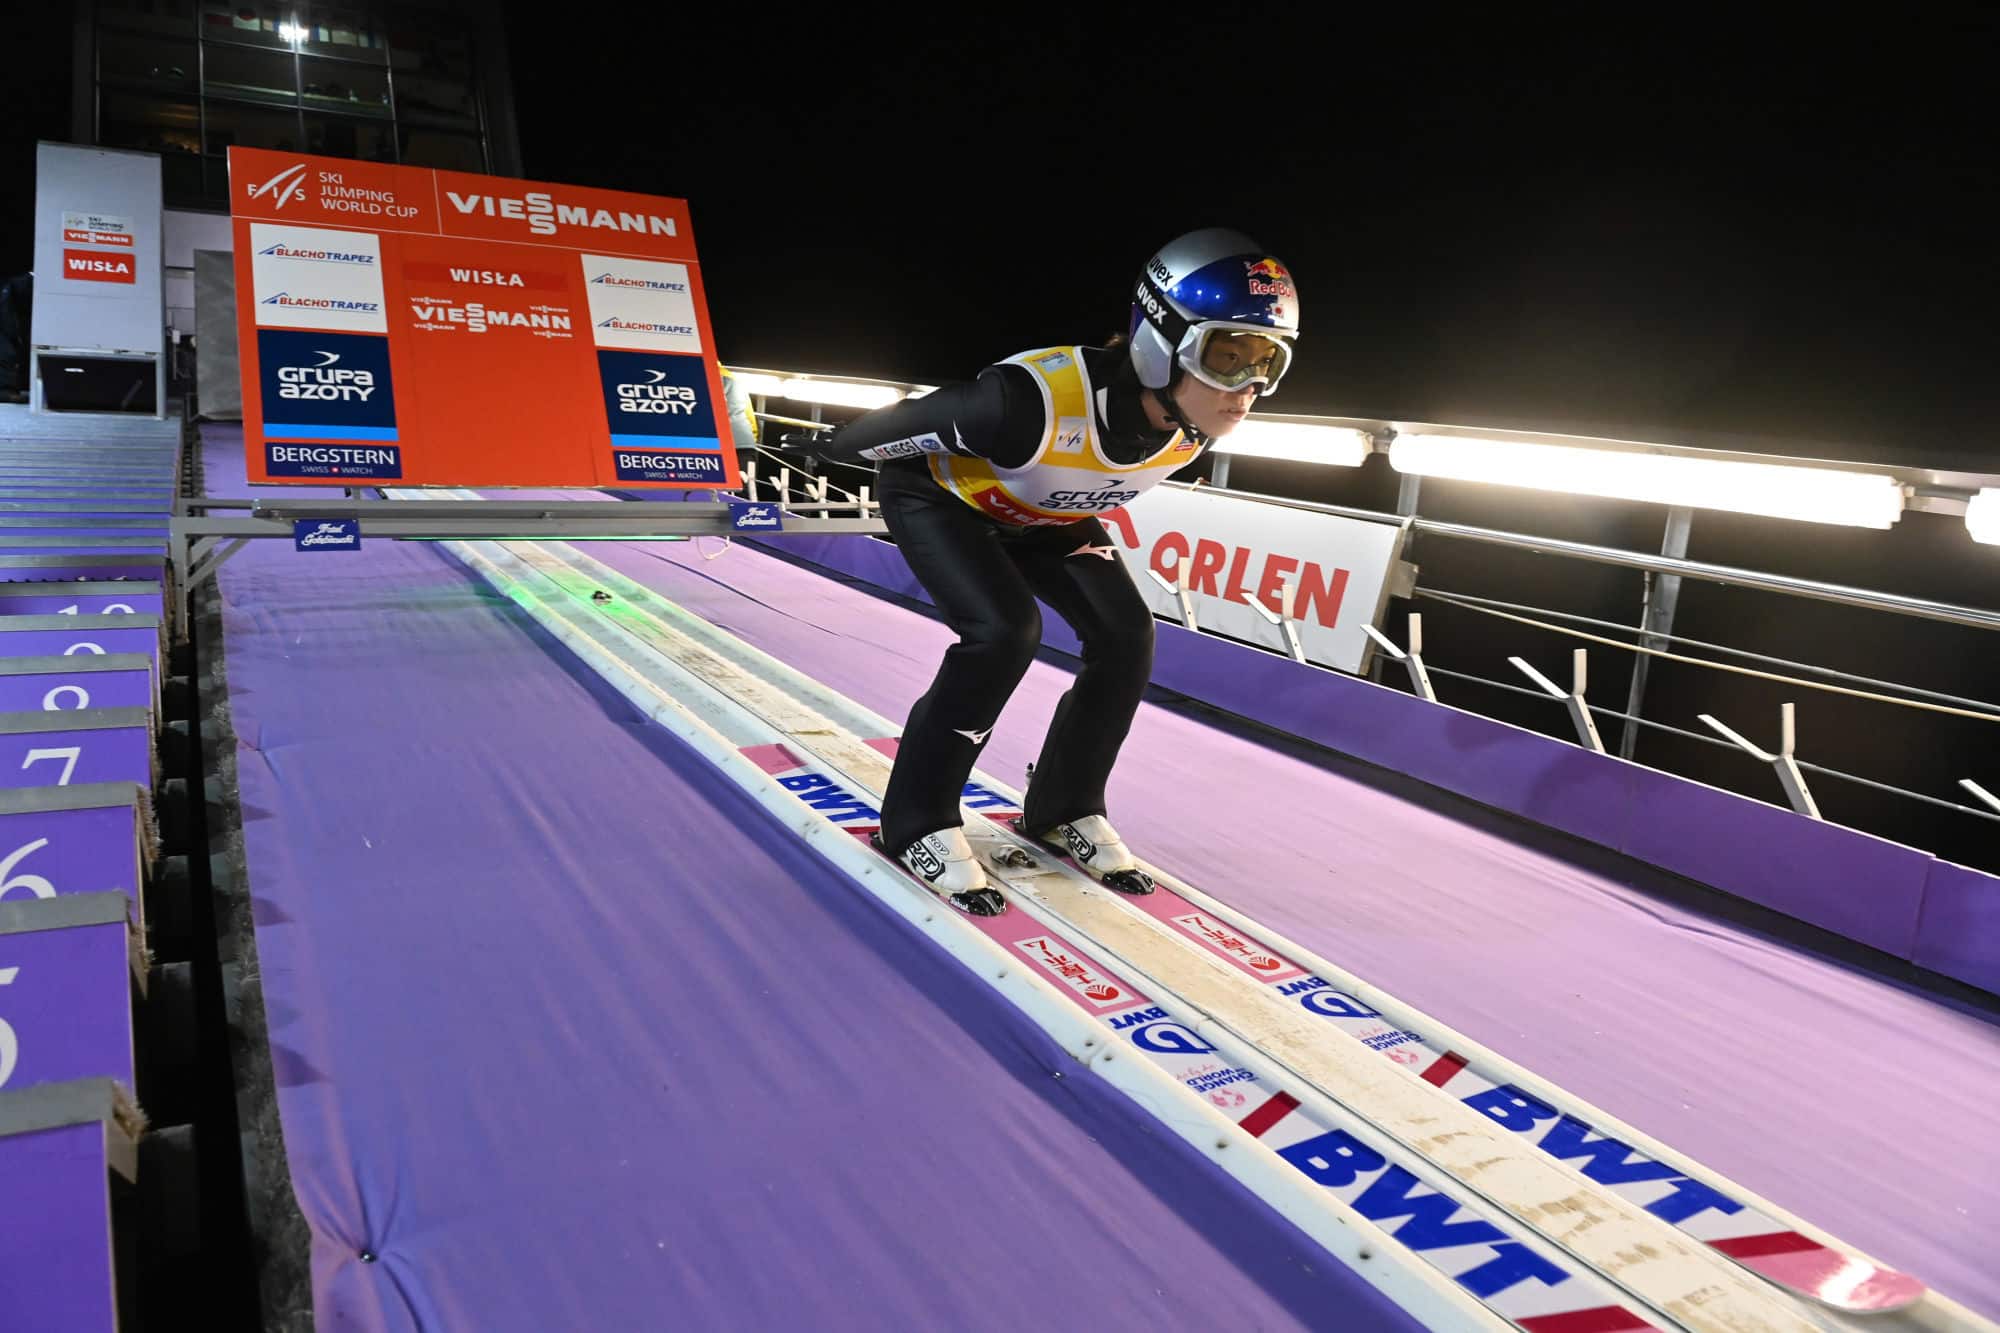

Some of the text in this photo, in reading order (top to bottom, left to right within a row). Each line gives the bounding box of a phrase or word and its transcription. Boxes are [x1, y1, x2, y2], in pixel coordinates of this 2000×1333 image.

[319, 172, 343, 185] SKI
[320, 186, 395, 204] JUMPING
[321, 198, 419, 218] WORLD CUP
[446, 192, 678, 237] VIESSMANN
[68, 258, 129, 274] WISŁA
[276, 248, 374, 264] BLACHOTRAPEZ
[450, 268, 525, 287] WISŁA
[1151, 255, 1174, 288] uvex
[604, 276, 685, 291] BLACHOTRAPEZ
[1249, 279, 1277, 295] Red
[279, 297, 378, 312] BLACHOTRAPEZ
[1137, 282, 1167, 325] uvex
[411, 303, 572, 332] VIESSMANN
[611, 320, 693, 335] BLACHOTRAPEZ
[272, 446, 395, 465] BERGSTERN
[619, 454, 720, 471] BERGSTERN
[300, 465, 373, 475] SWISS WATCH
[1149, 531, 1350, 629] ORLEN
[22, 747, 81, 786] 7
[776, 773, 881, 822] BWT
[960, 783, 1019, 808] WT
[1276, 976, 1331, 996] BWT
[1109, 1006, 1170, 1030] BWT
[1186, 1068, 1236, 1086] WORLD
[1194, 1070, 1256, 1093] CHANGE
[1461, 1083, 1745, 1224] BWT
[1275, 1129, 1571, 1298] BWT
